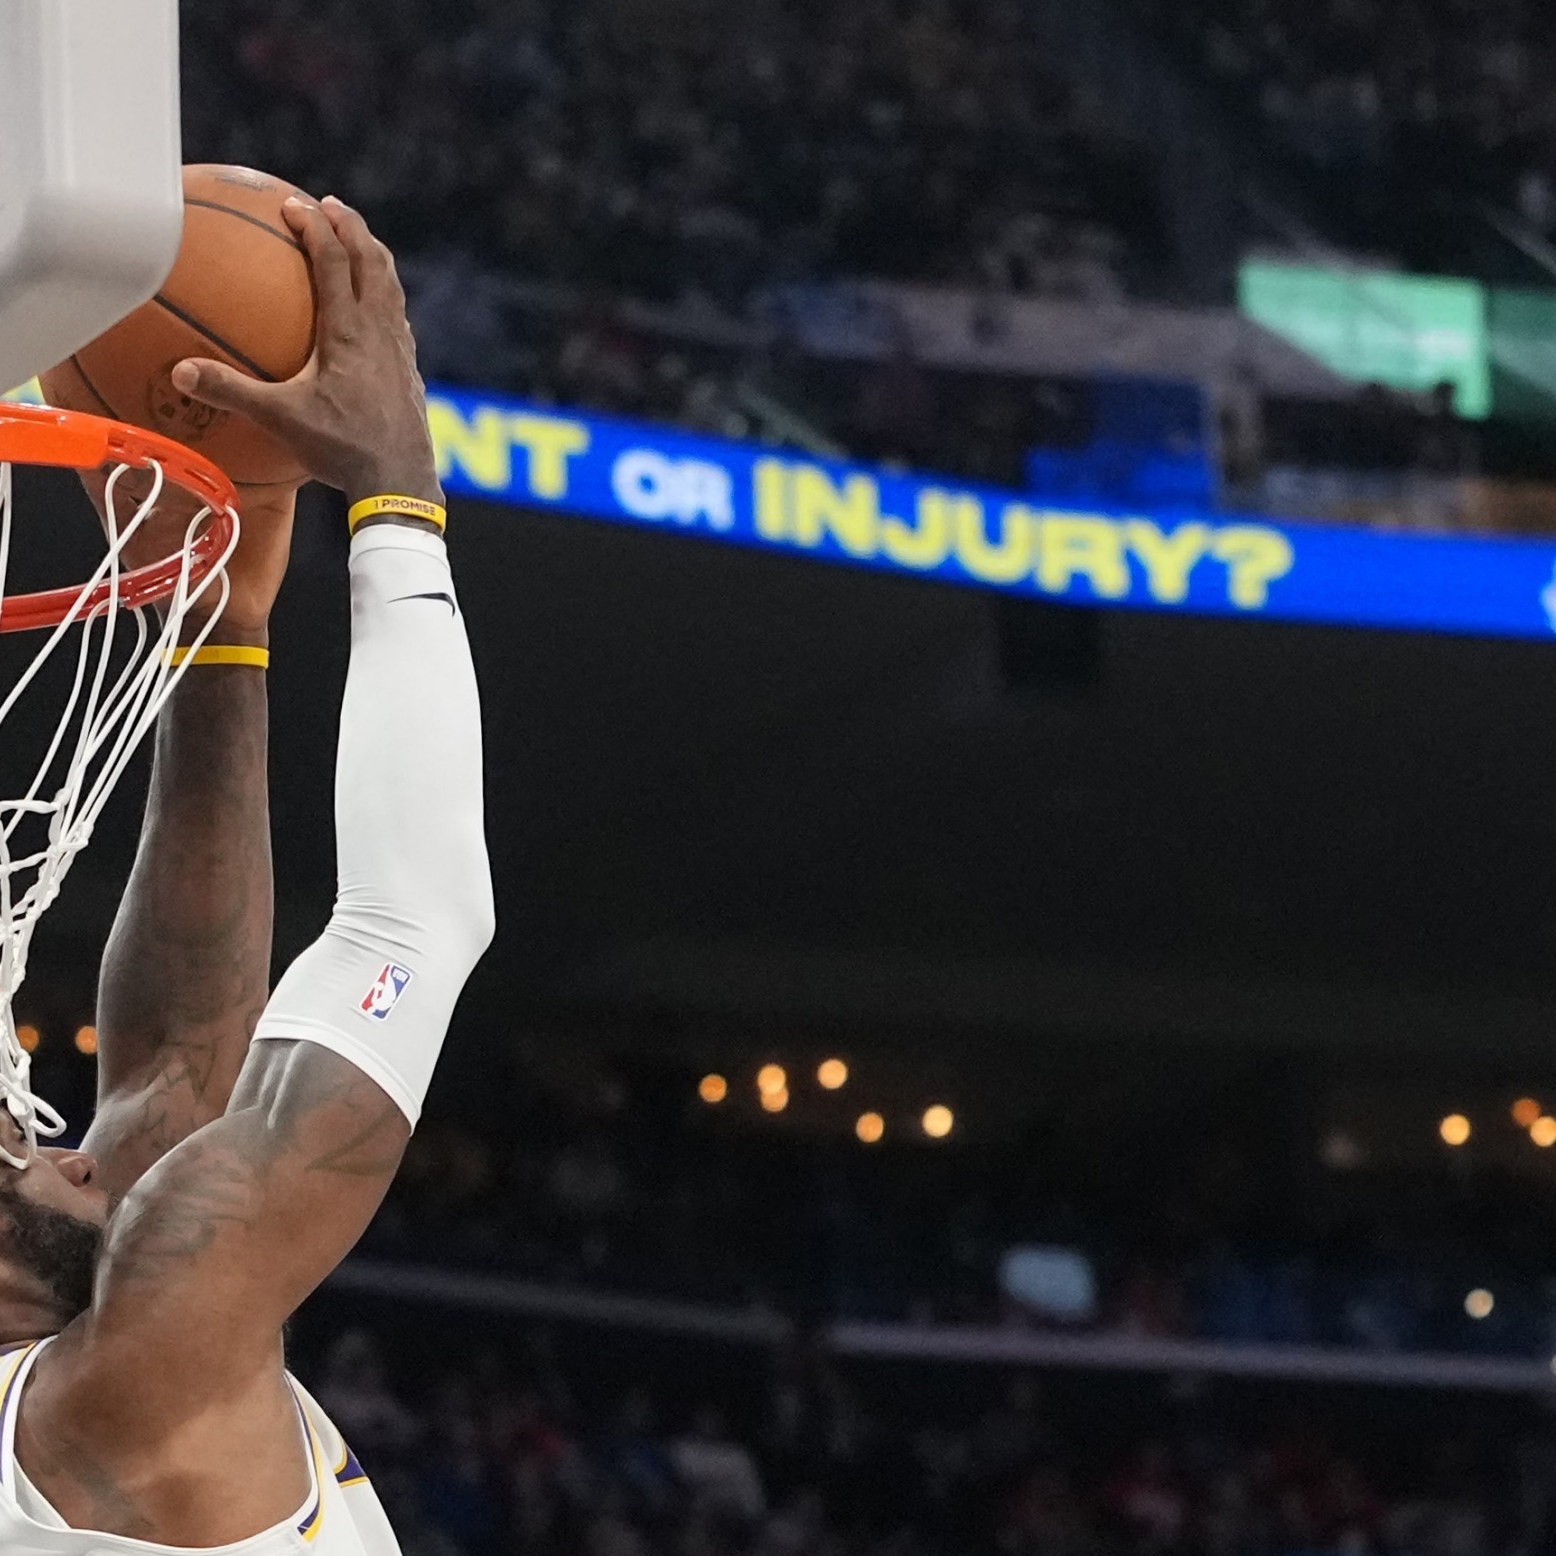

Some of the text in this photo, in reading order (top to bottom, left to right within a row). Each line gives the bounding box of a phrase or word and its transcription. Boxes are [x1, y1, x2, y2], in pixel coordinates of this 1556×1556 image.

[381, 498, 437, 517] PROMISE
[611, 449, 736, 533] OR
[752, 456, 1294, 609] INJURY?
